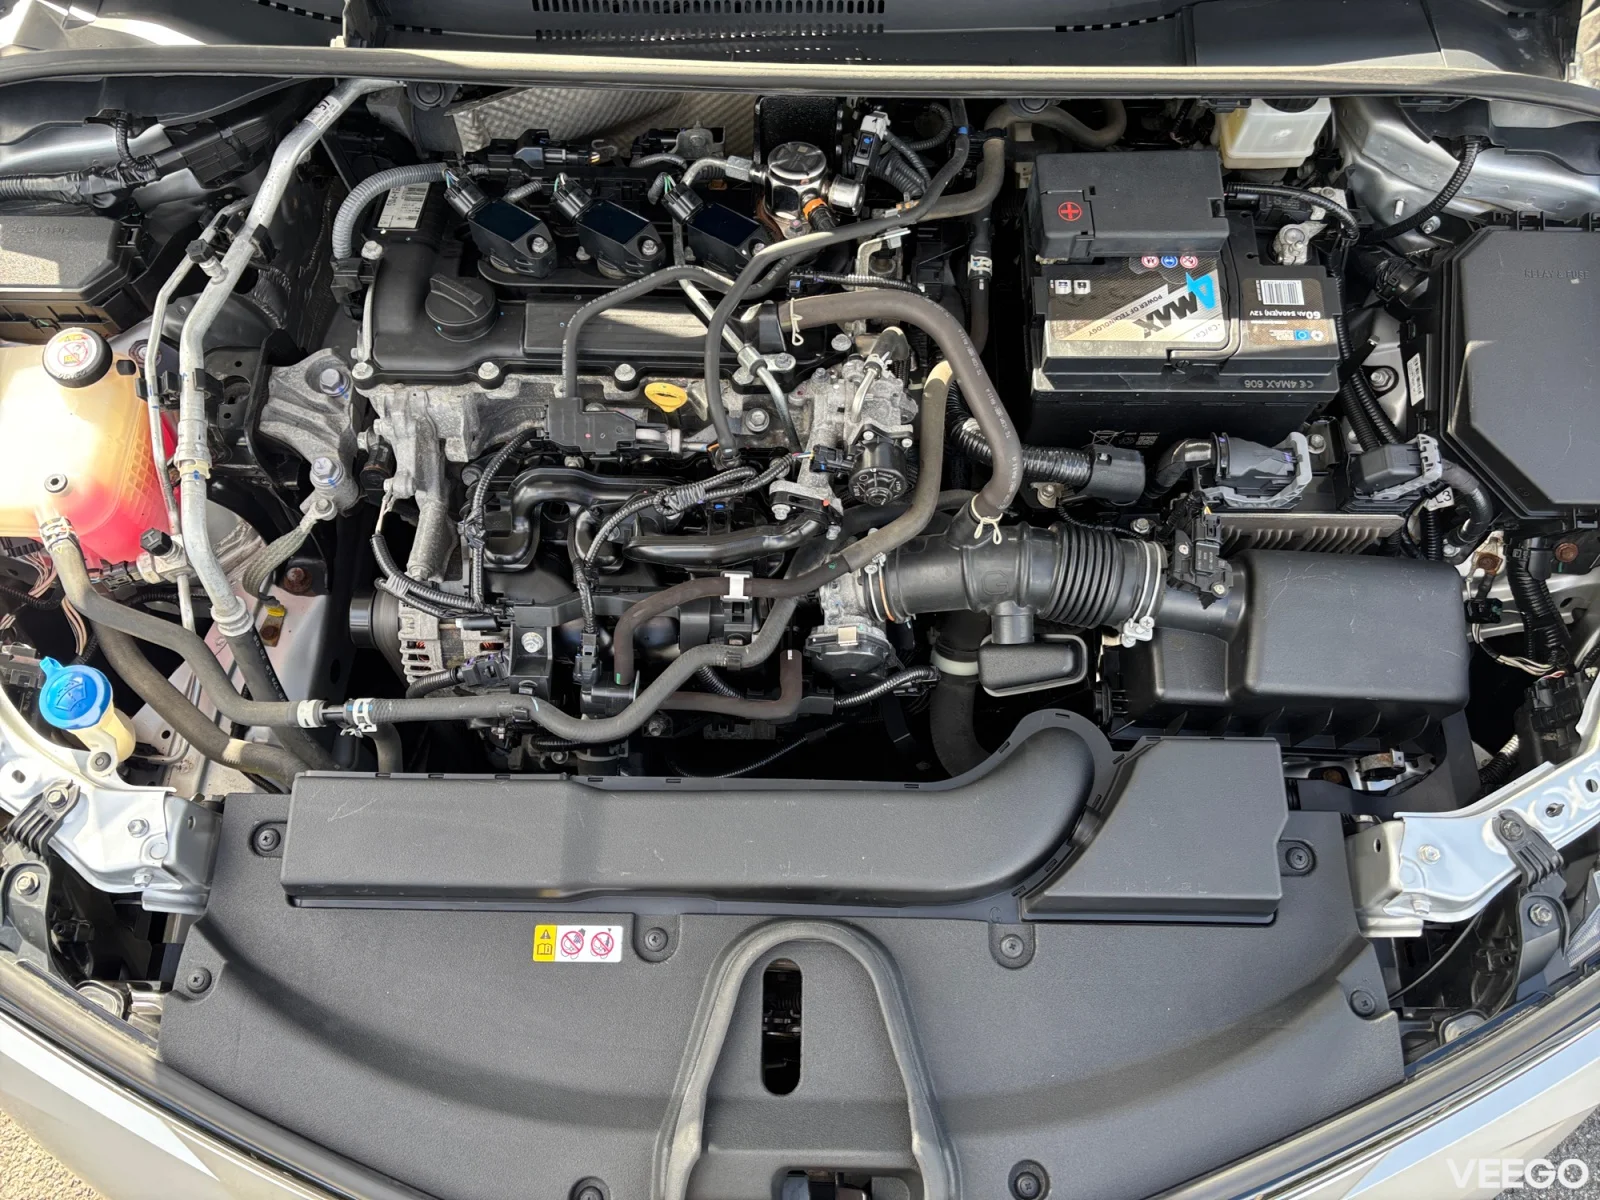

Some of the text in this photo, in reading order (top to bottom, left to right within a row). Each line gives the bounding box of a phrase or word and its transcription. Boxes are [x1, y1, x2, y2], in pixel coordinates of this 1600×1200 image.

[1524, 269, 1553, 279] RELAY
[1566, 269, 1589, 280] FUSE
[1088, 293, 1163, 337] POWER OF TECHNOLOGY
[1243, 379, 1264, 389] 606
[1265, 379, 1297, 389] 4MAX
[1435, 490, 1452, 504] L3
[142, 530, 160, 547] H
